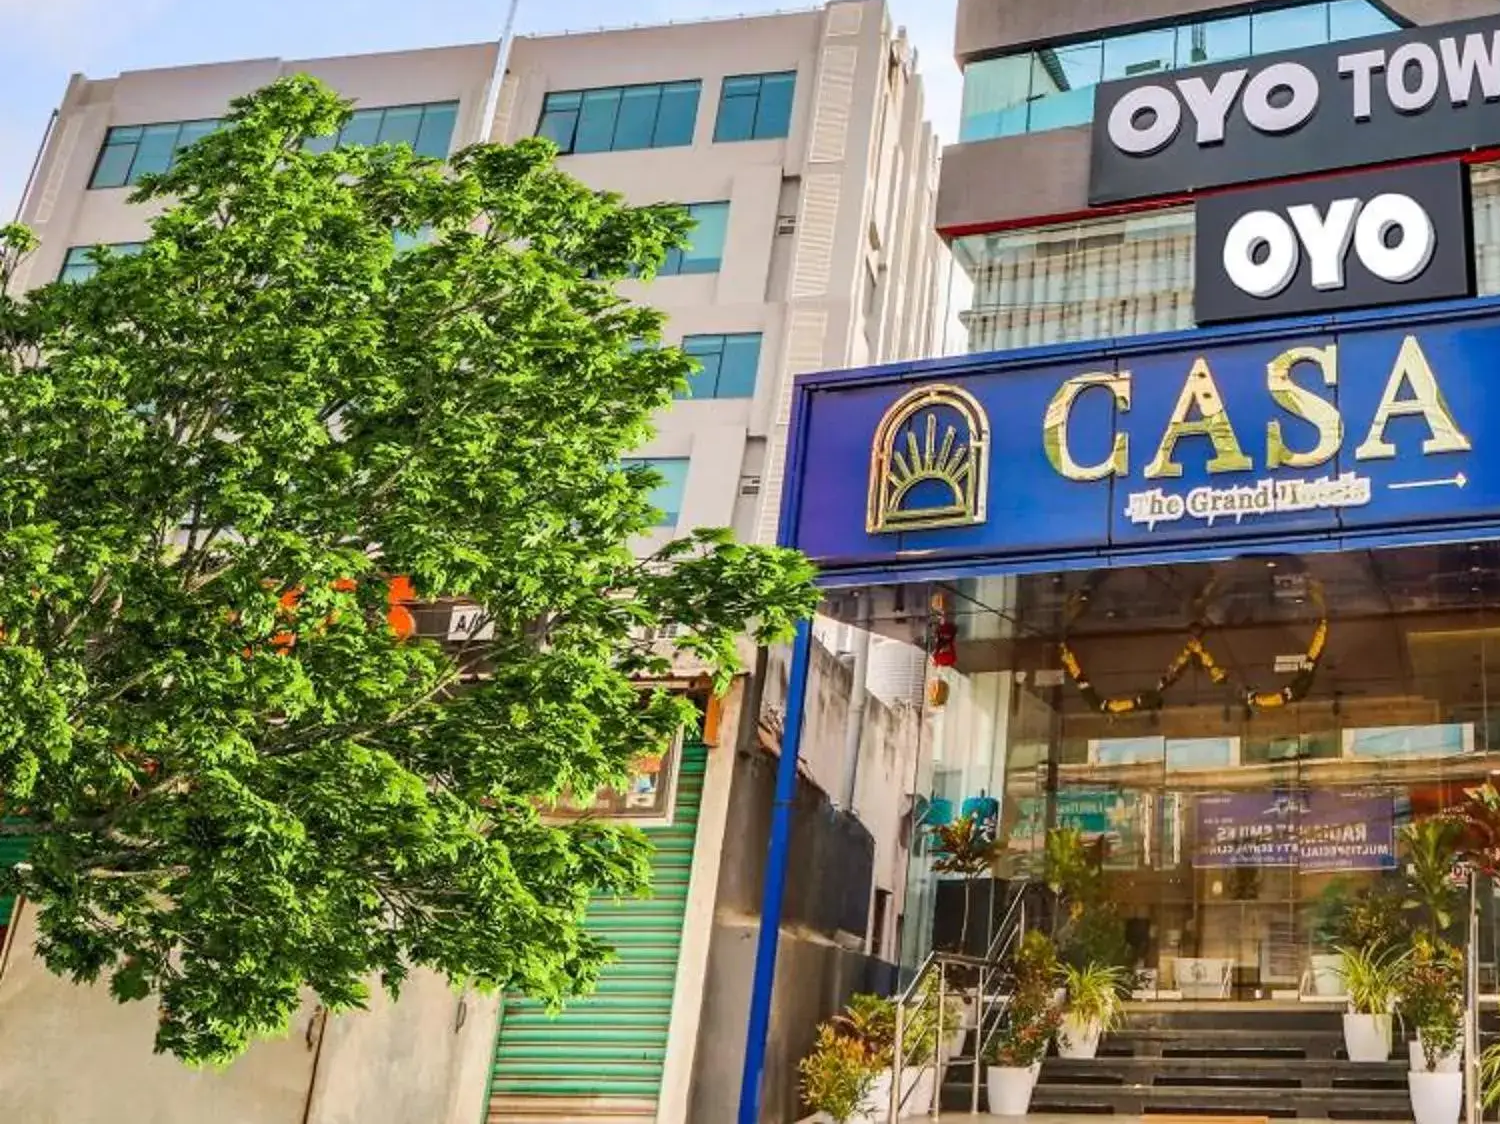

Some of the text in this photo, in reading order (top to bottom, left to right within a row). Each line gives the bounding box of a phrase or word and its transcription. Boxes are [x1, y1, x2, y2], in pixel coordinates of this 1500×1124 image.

[1108, 62, 1319, 155] OYO
[1223, 193, 1437, 297] OYO
[1044, 335, 1471, 480] CASA
[1131, 492, 1182, 516] The
[1189, 485, 1269, 513] Grand
